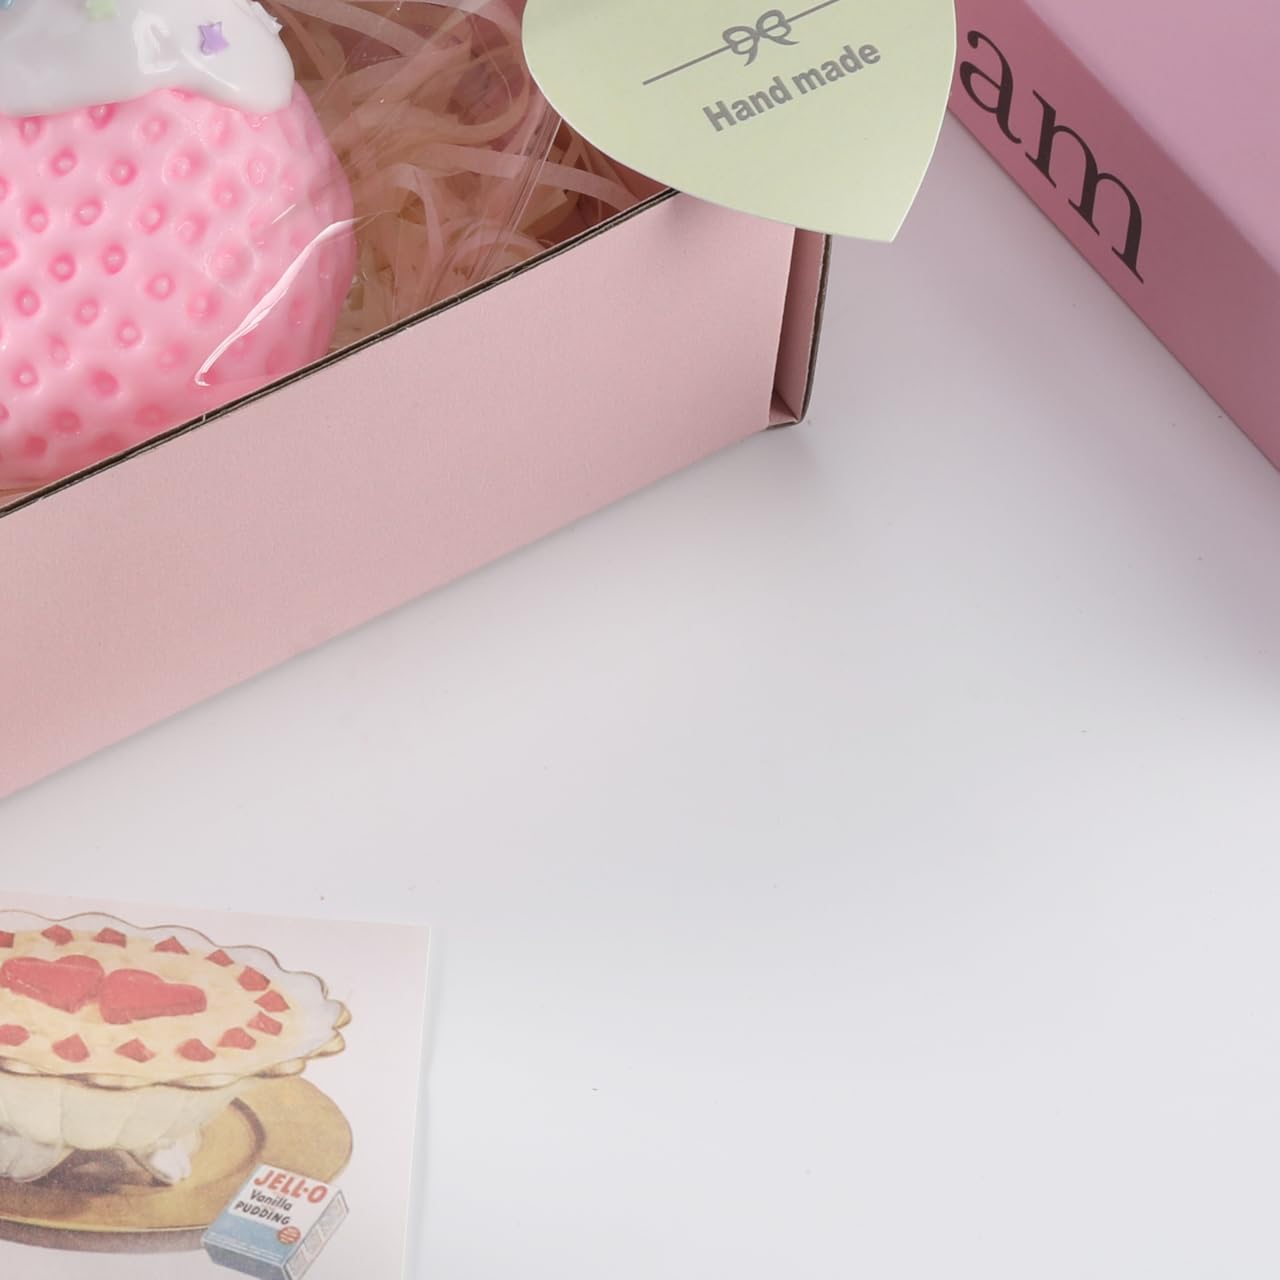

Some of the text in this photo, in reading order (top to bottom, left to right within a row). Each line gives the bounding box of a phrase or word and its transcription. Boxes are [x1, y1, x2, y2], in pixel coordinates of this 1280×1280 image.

[702, 44, 881, 132] Hand made
[250, 1189, 293, 1211] Vanilla
[253, 1169, 328, 1204] JELL-O
[234, 1200, 291, 1225] PUDDING
